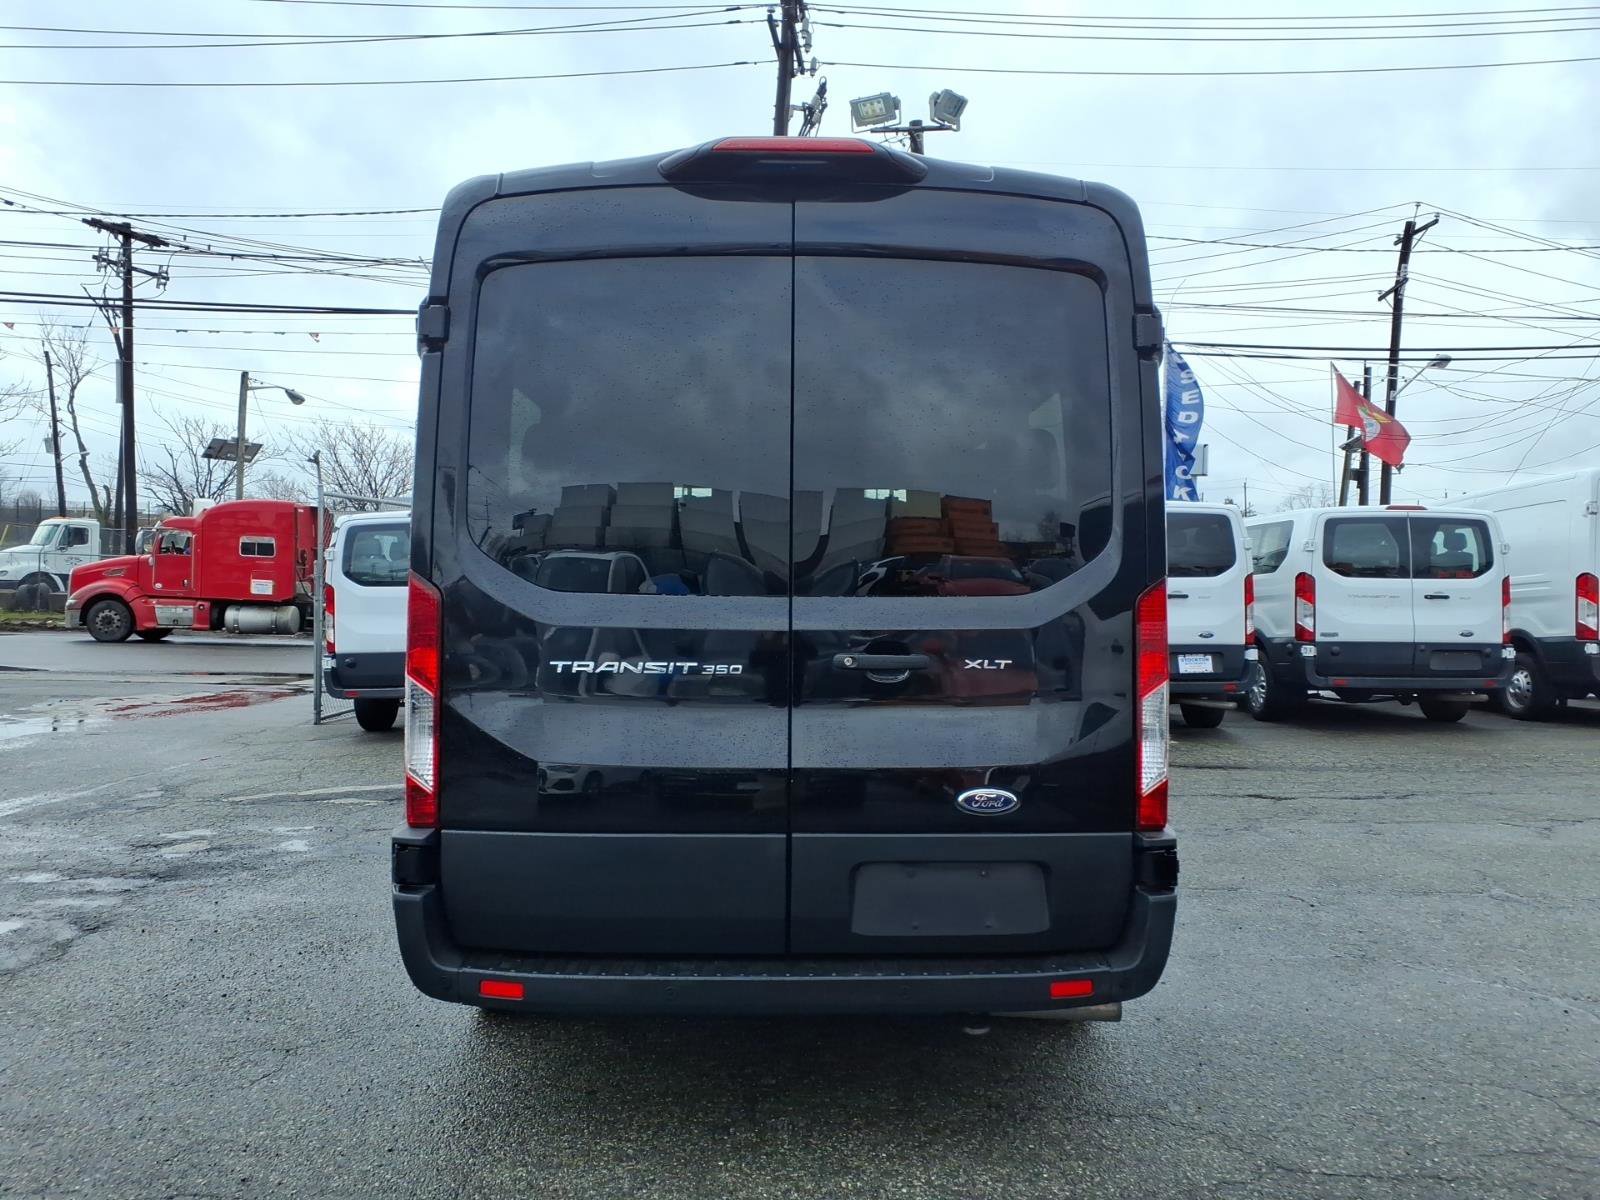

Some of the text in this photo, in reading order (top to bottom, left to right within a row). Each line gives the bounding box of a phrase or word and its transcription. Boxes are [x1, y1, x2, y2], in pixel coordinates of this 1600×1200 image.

[549, 660, 743, 675] TRANSIT 350
[963, 658, 1013, 670] XLT
[971, 792, 1006, 809] Ford
